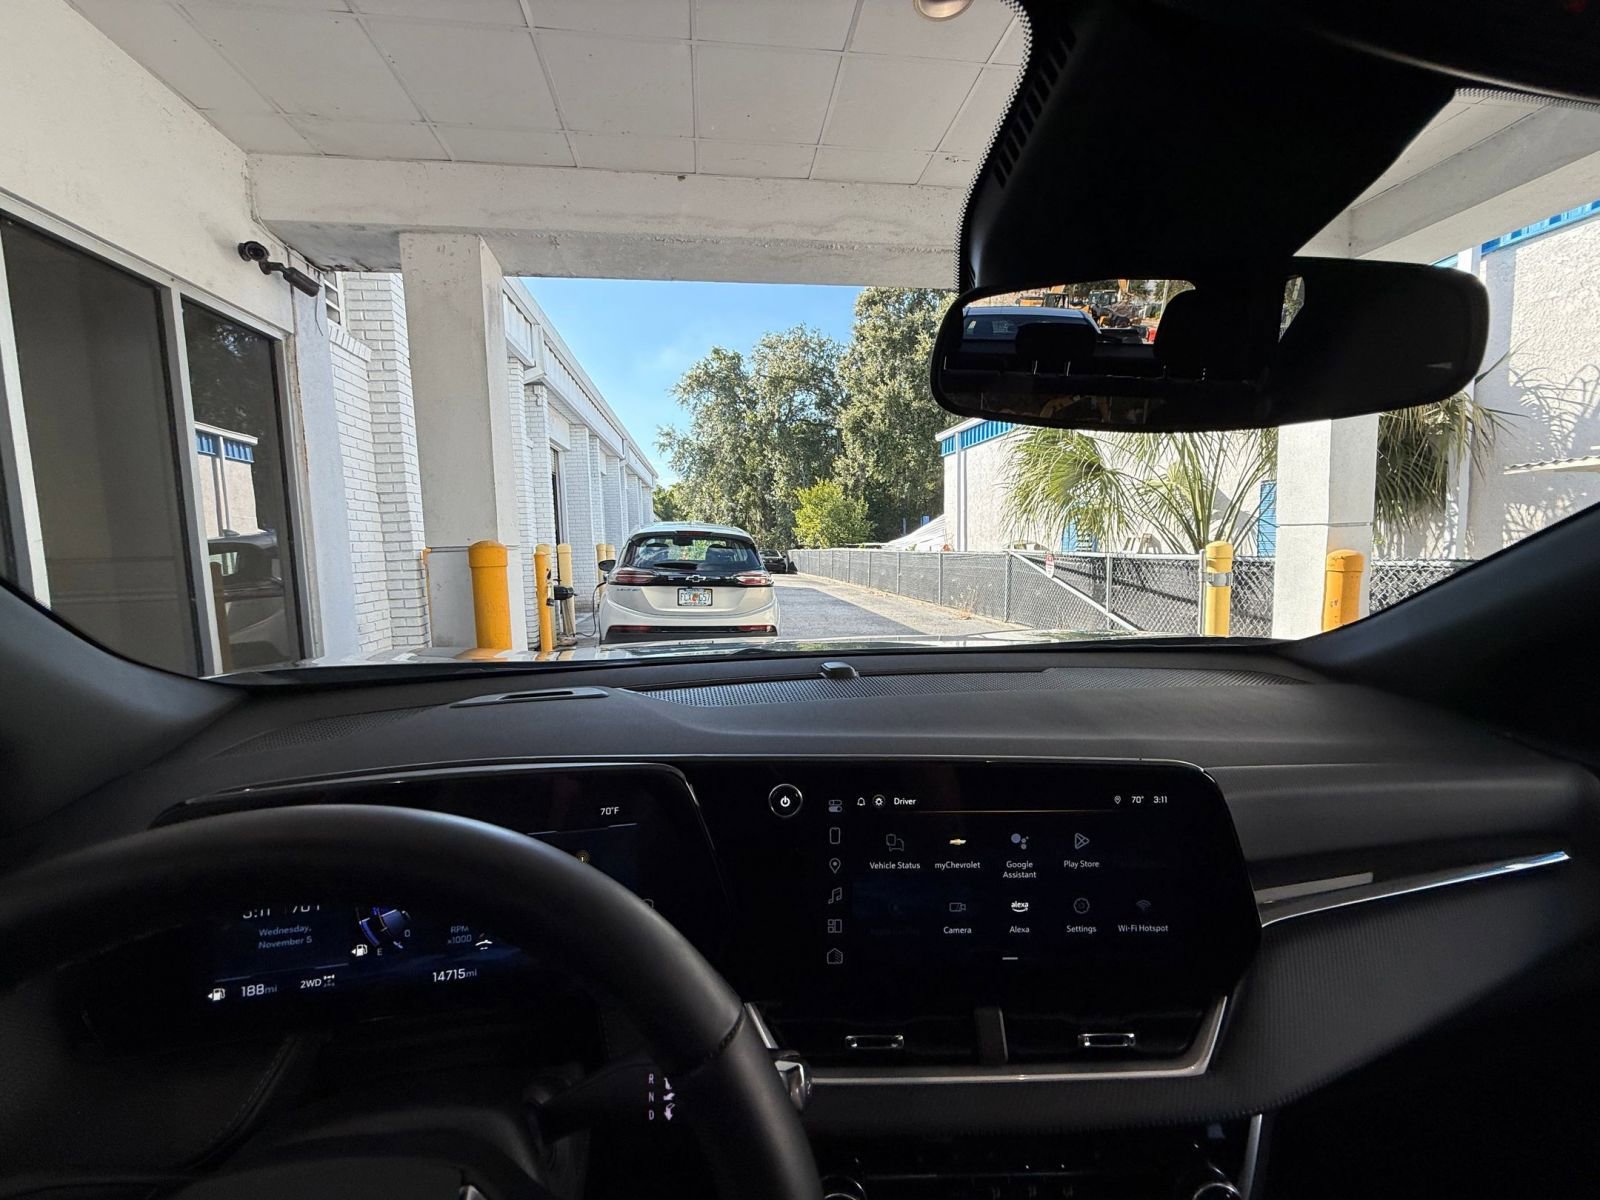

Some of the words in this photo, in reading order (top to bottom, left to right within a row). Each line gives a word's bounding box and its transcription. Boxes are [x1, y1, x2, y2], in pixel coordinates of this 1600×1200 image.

[893, 797, 917, 806] Driver
[1153, 795, 1168, 804] 3:11
[600, 806, 620, 816] 70°F
[869, 861, 896, 870] Vehicle
[897, 861, 921, 870] Status
[934, 860, 981, 871] myChevrolet
[1005, 860, 1034, 870] Google
[1063, 860, 1079, 870] Play
[1080, 859, 1100, 868] Store
[1002, 870, 1037, 879] Assistant
[1011, 900, 1029, 908] alexa
[450, 925, 470, 934] RPM
[943, 926, 972, 935] Camera
[1009, 925, 1030, 934] Alexa
[1066, 924, 1097, 934] Settings
[1117, 924, 1138, 933] Wi-Fi
[1138, 924, 1169, 934] Hotspot
[258, 937, 304, 949] November
[305, 935, 313, 944] 5
[300, 978, 322, 989] 2WD
[648, 1073, 655, 1084] R
[648, 1091, 655, 1103] N
[648, 1110, 655, 1121] D
